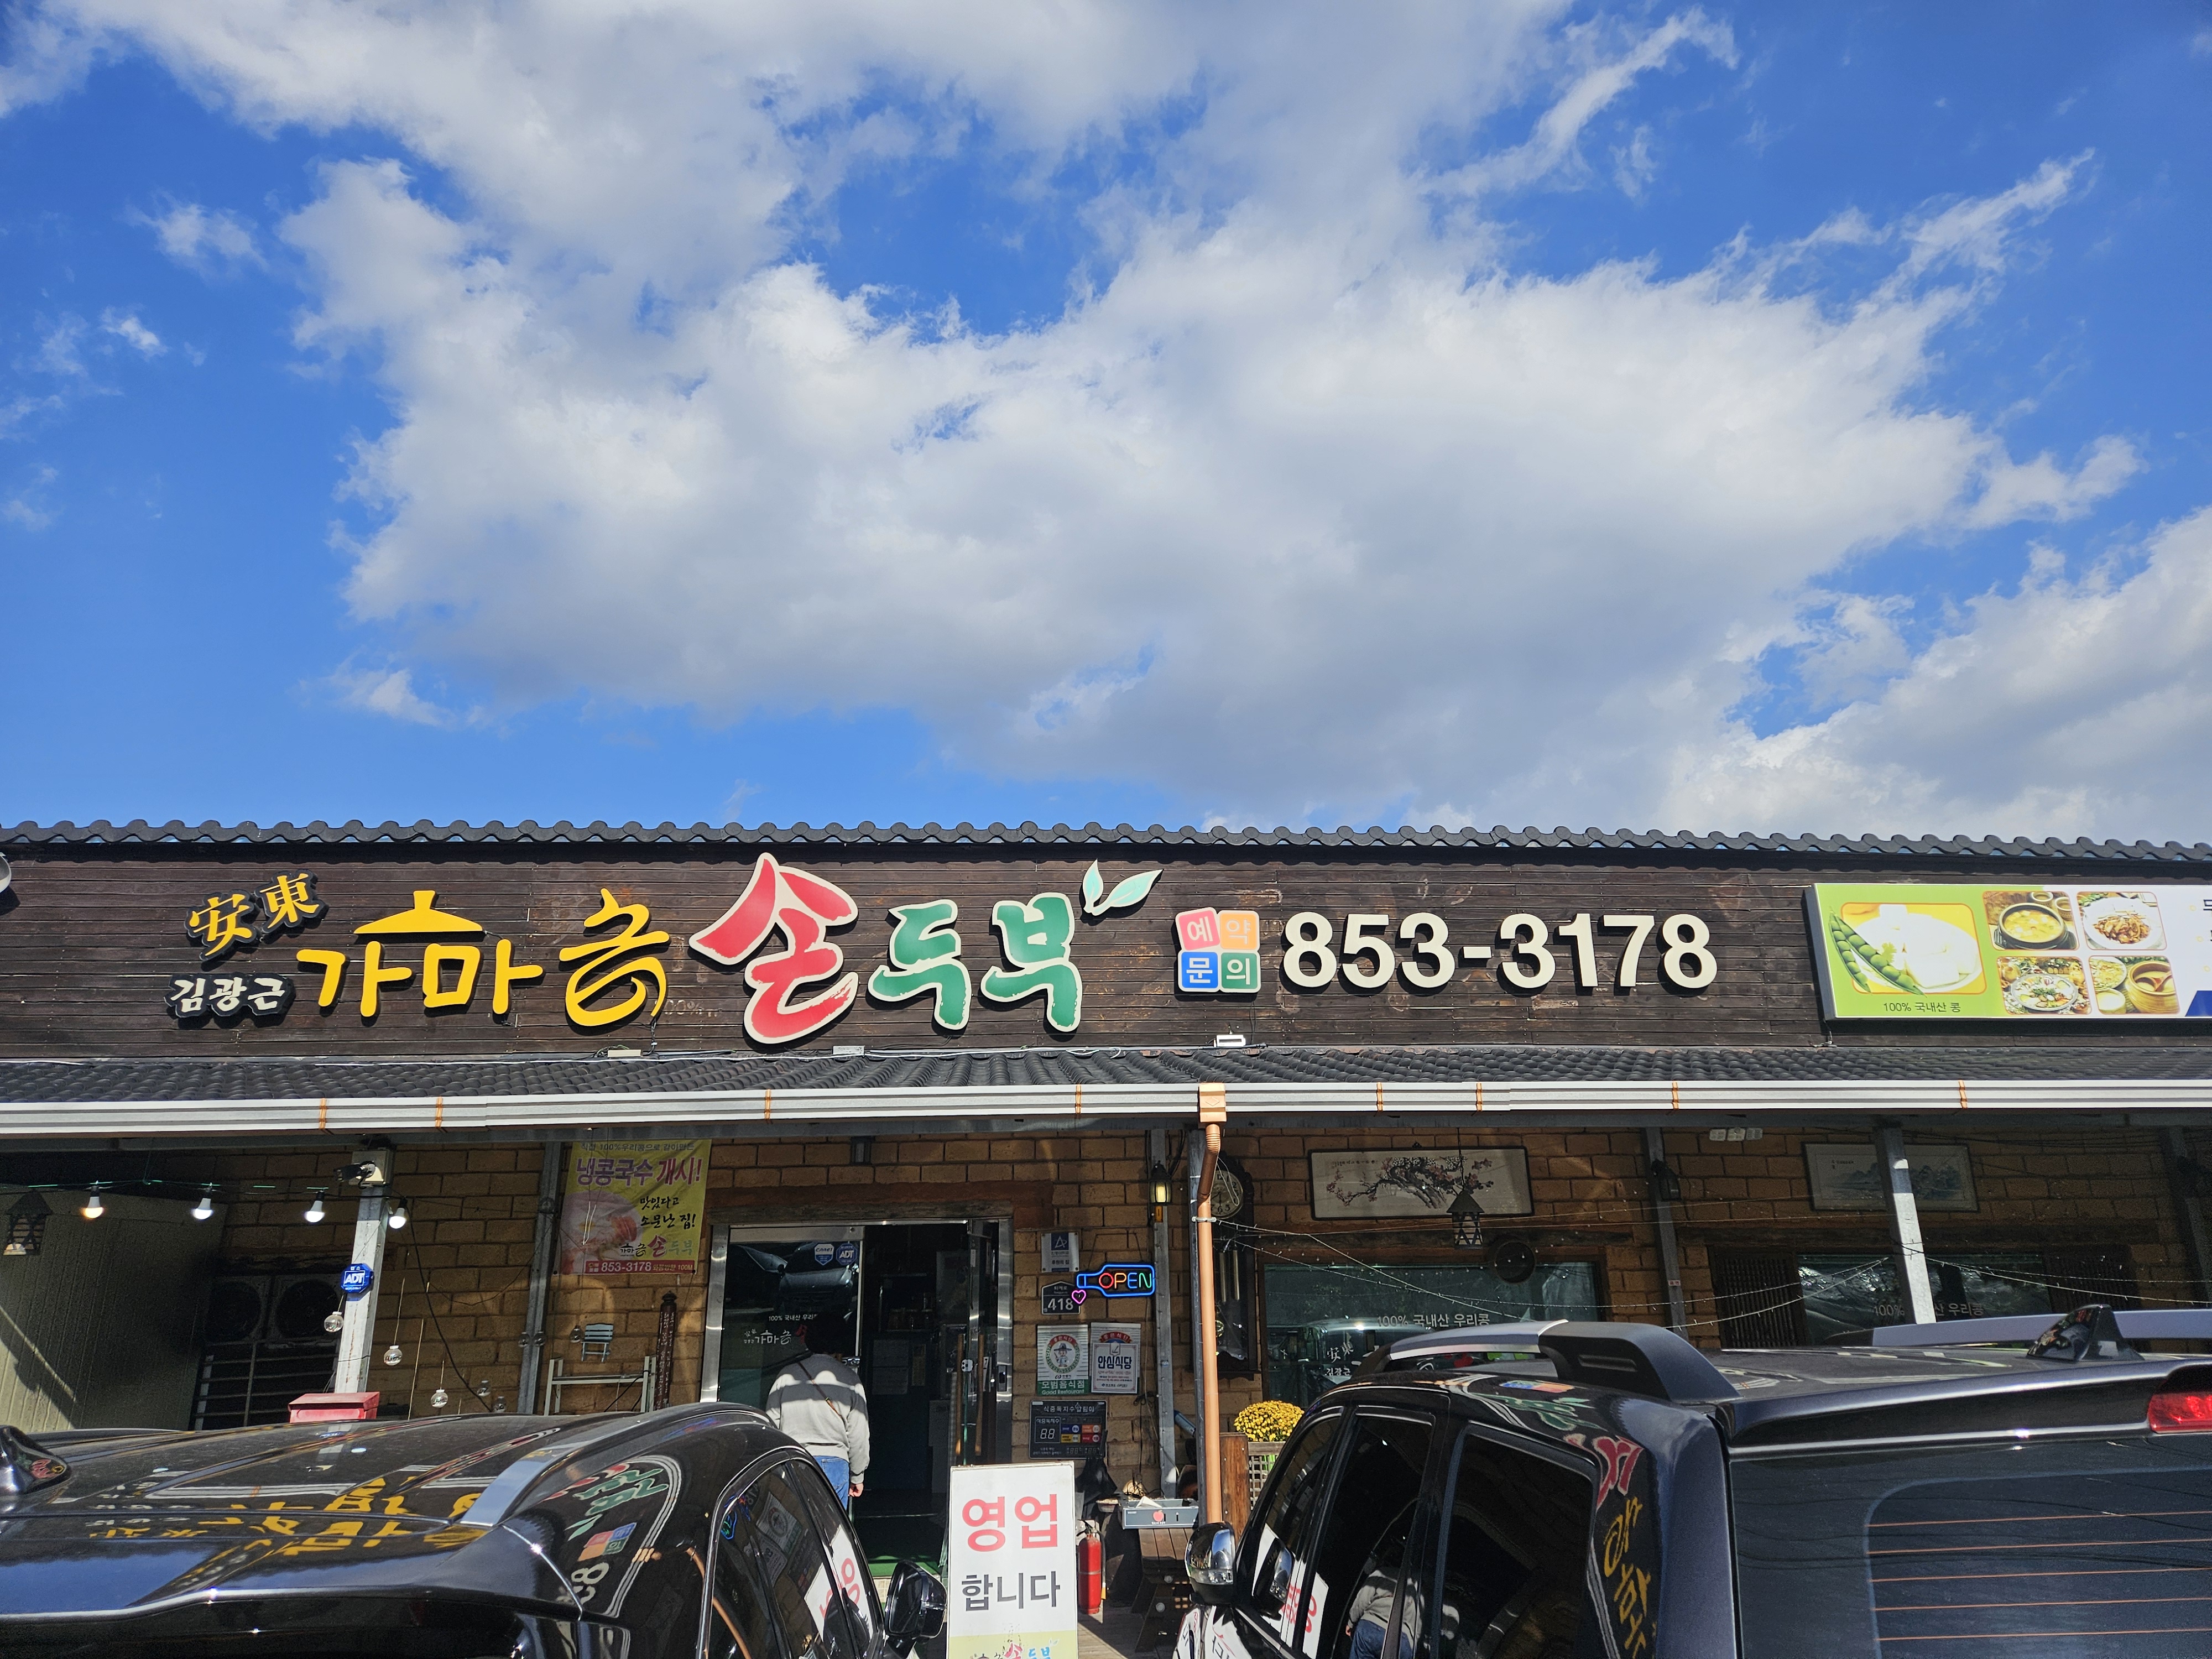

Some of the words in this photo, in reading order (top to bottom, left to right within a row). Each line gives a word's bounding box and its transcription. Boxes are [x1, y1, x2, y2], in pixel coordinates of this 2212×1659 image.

[189, 873, 320, 957] 安東
[1186, 920, 1251, 947] 예약
[689, 852, 1082, 1045] 손두부
[1283, 911, 1718, 989] 853-3178
[1185, 954, 1250, 986] 문의
[170, 978, 285, 1015] 김광근
[1884, 1002, 1912, 1011] 100%
[1914, 1002, 1947, 1013] 국내산
[1950, 1002, 1961, 1013] 콩
[577, 1157, 654, 1186] 냉콩국수
[656, 1157, 702, 1186] 개시!
[640, 1196, 680, 1211] 맛있다고
[640, 1213, 675, 1229] 소문난
[679, 1213, 697, 1229] 집!
[839, 1250, 854, 1259] ADT
[601, 1261, 652, 1272] 853-3178
[345, 1273, 365, 1284] ADT
[1098, 1272, 1152, 1289] OPEN
[1047, 1298, 1074, 1311] 418
[1874, 1305, 1905, 1317] 100%
[1948, 1302, 1984, 1317] 우리콩
[1376, 1315, 1409, 1327] 100%
[1413, 1313, 1450, 1327] 국내산
[1453, 1313, 1490, 1327] 우리콩
[1327, 1341, 1354, 1363] 安東
[1098, 1355, 1132, 1369] 안심식당
[1041, 1380, 1084, 1390] 모범음식점
[1040, 1428, 1055, 1439] 88
[962, 1494, 1058, 1552] 영업
[961, 1571, 1061, 1612] 합니다
